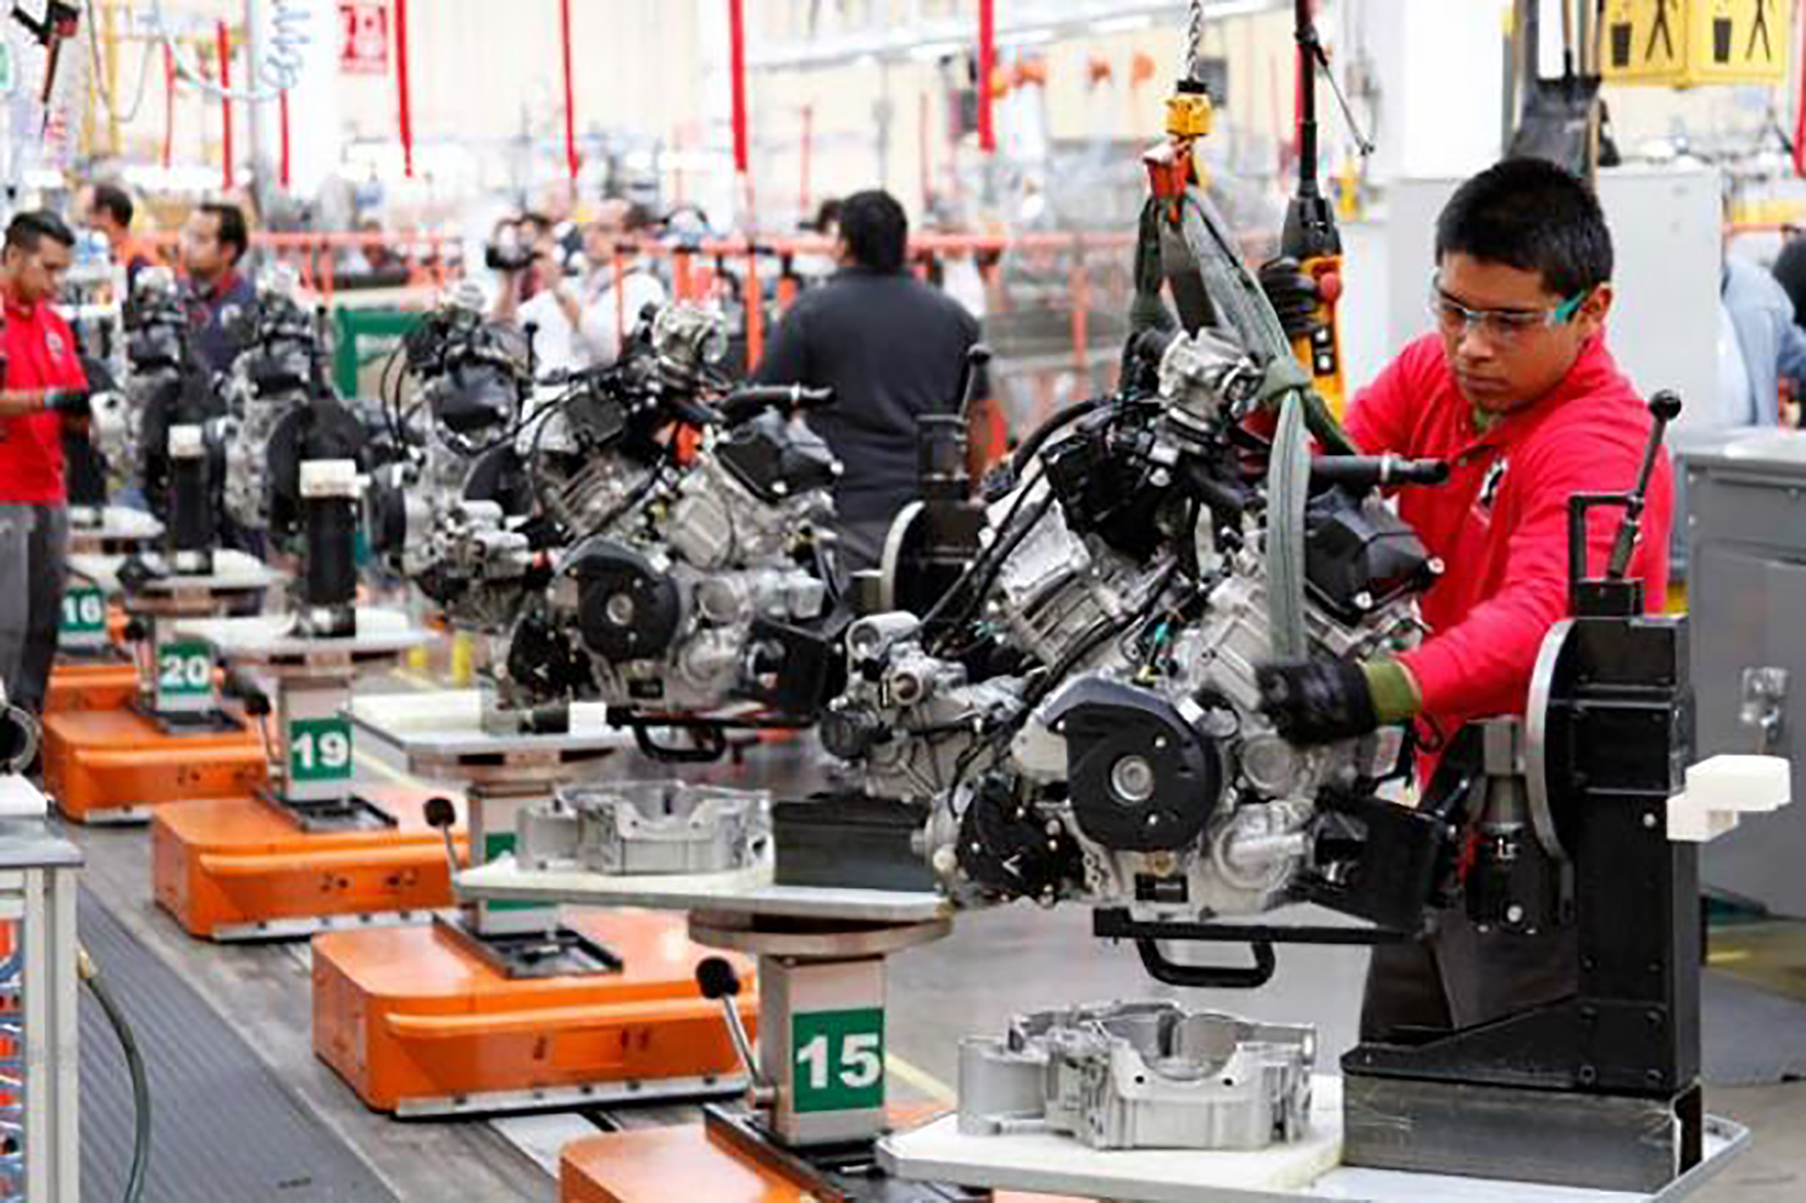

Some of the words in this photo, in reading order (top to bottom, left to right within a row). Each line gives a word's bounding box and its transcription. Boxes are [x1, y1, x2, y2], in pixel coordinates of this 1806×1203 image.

[160, 655, 210, 686] 20
[291, 731, 348, 768] 19
[797, 1033, 880, 1089] 15
